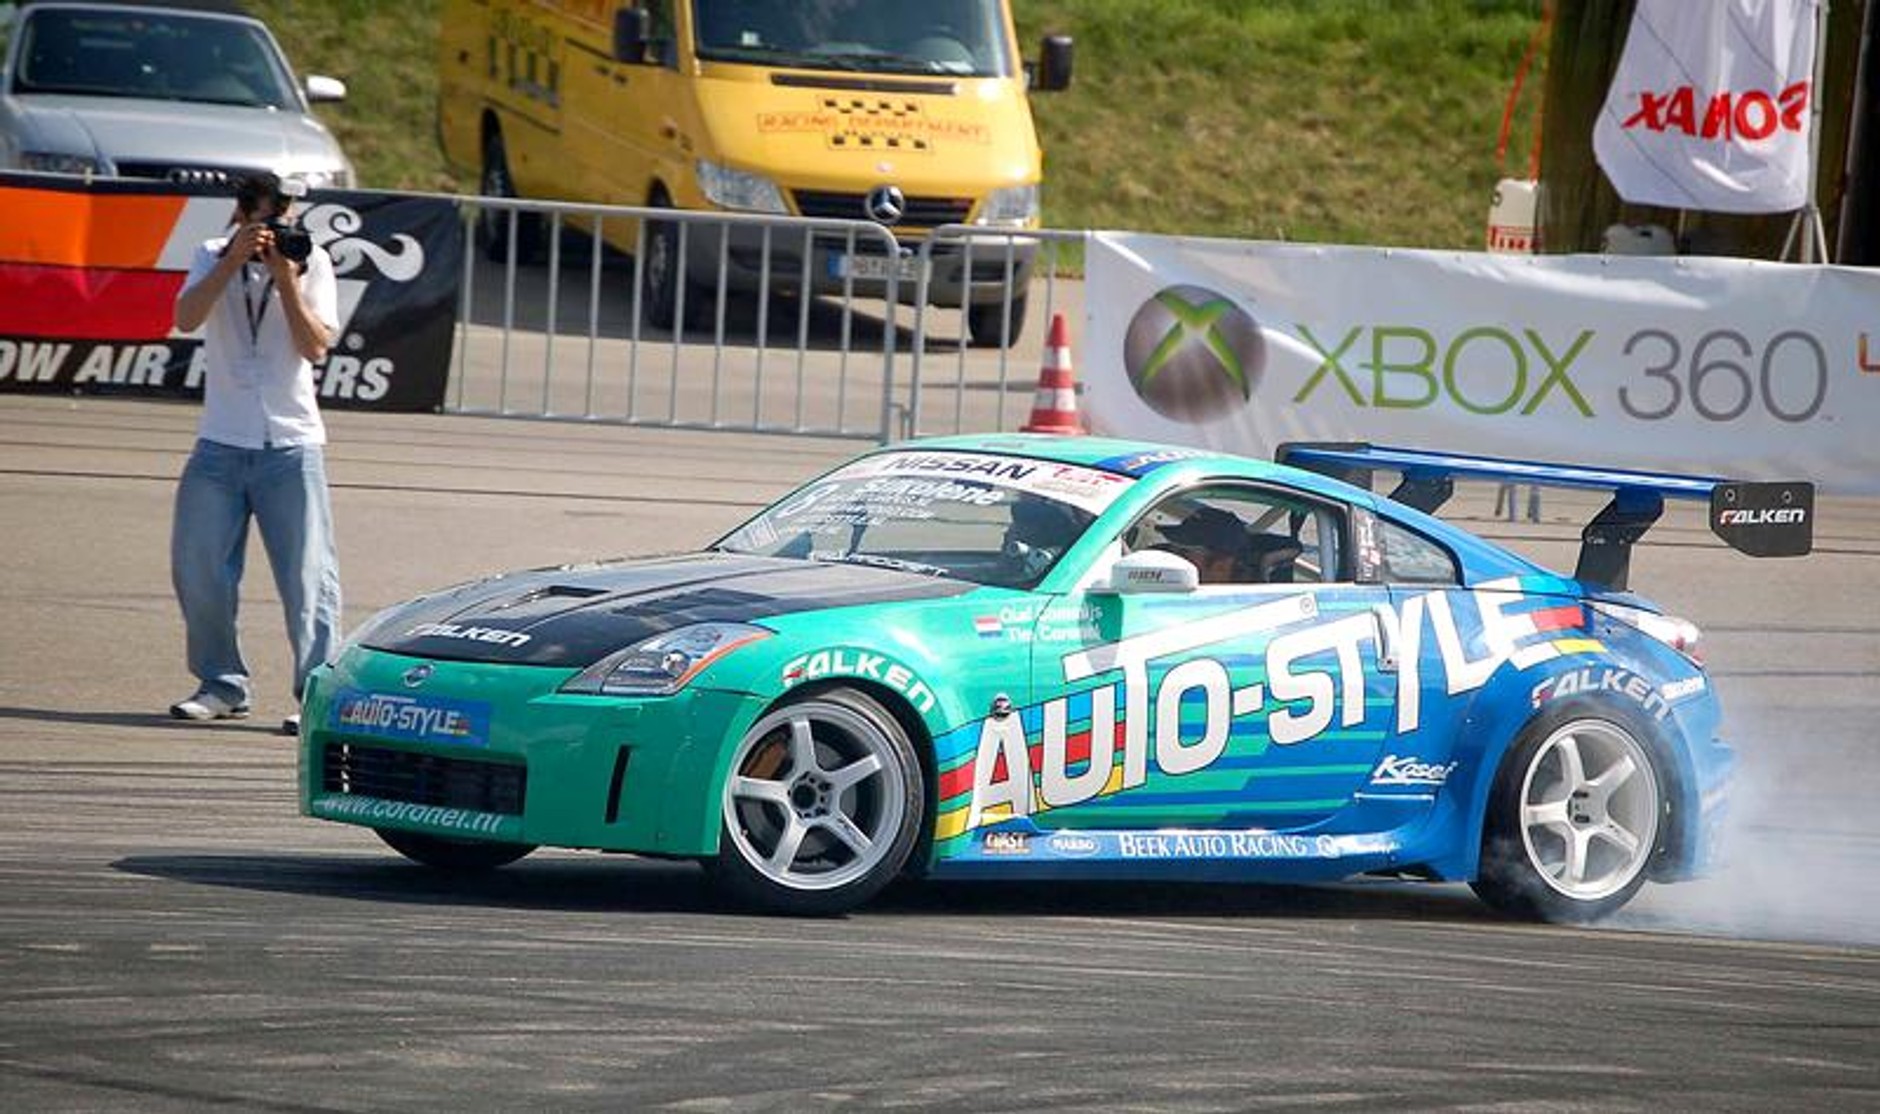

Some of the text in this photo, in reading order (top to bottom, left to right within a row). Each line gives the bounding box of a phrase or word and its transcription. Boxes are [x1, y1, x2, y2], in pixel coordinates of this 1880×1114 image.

[74, 344, 172, 386] AIR
[1294, 325, 1597, 418] XBOX
[1619, 330, 1828, 422] 360
[885, 456, 1037, 480] NISSAN
[1719, 507, 1806, 525] FALKEN
[404, 622, 532, 647] FALKEN
[781, 650, 936, 714] FALKEN
[968, 576, 1562, 828] AUTO-STYLE
[1531, 668, 1672, 721] FALKEN
[349, 693, 461, 737] AUTO-STYLE
[1118, 833, 1172, 857] BEEK
[1174, 834, 1226, 857] AUTO
[1230, 834, 1307, 858] RACING
